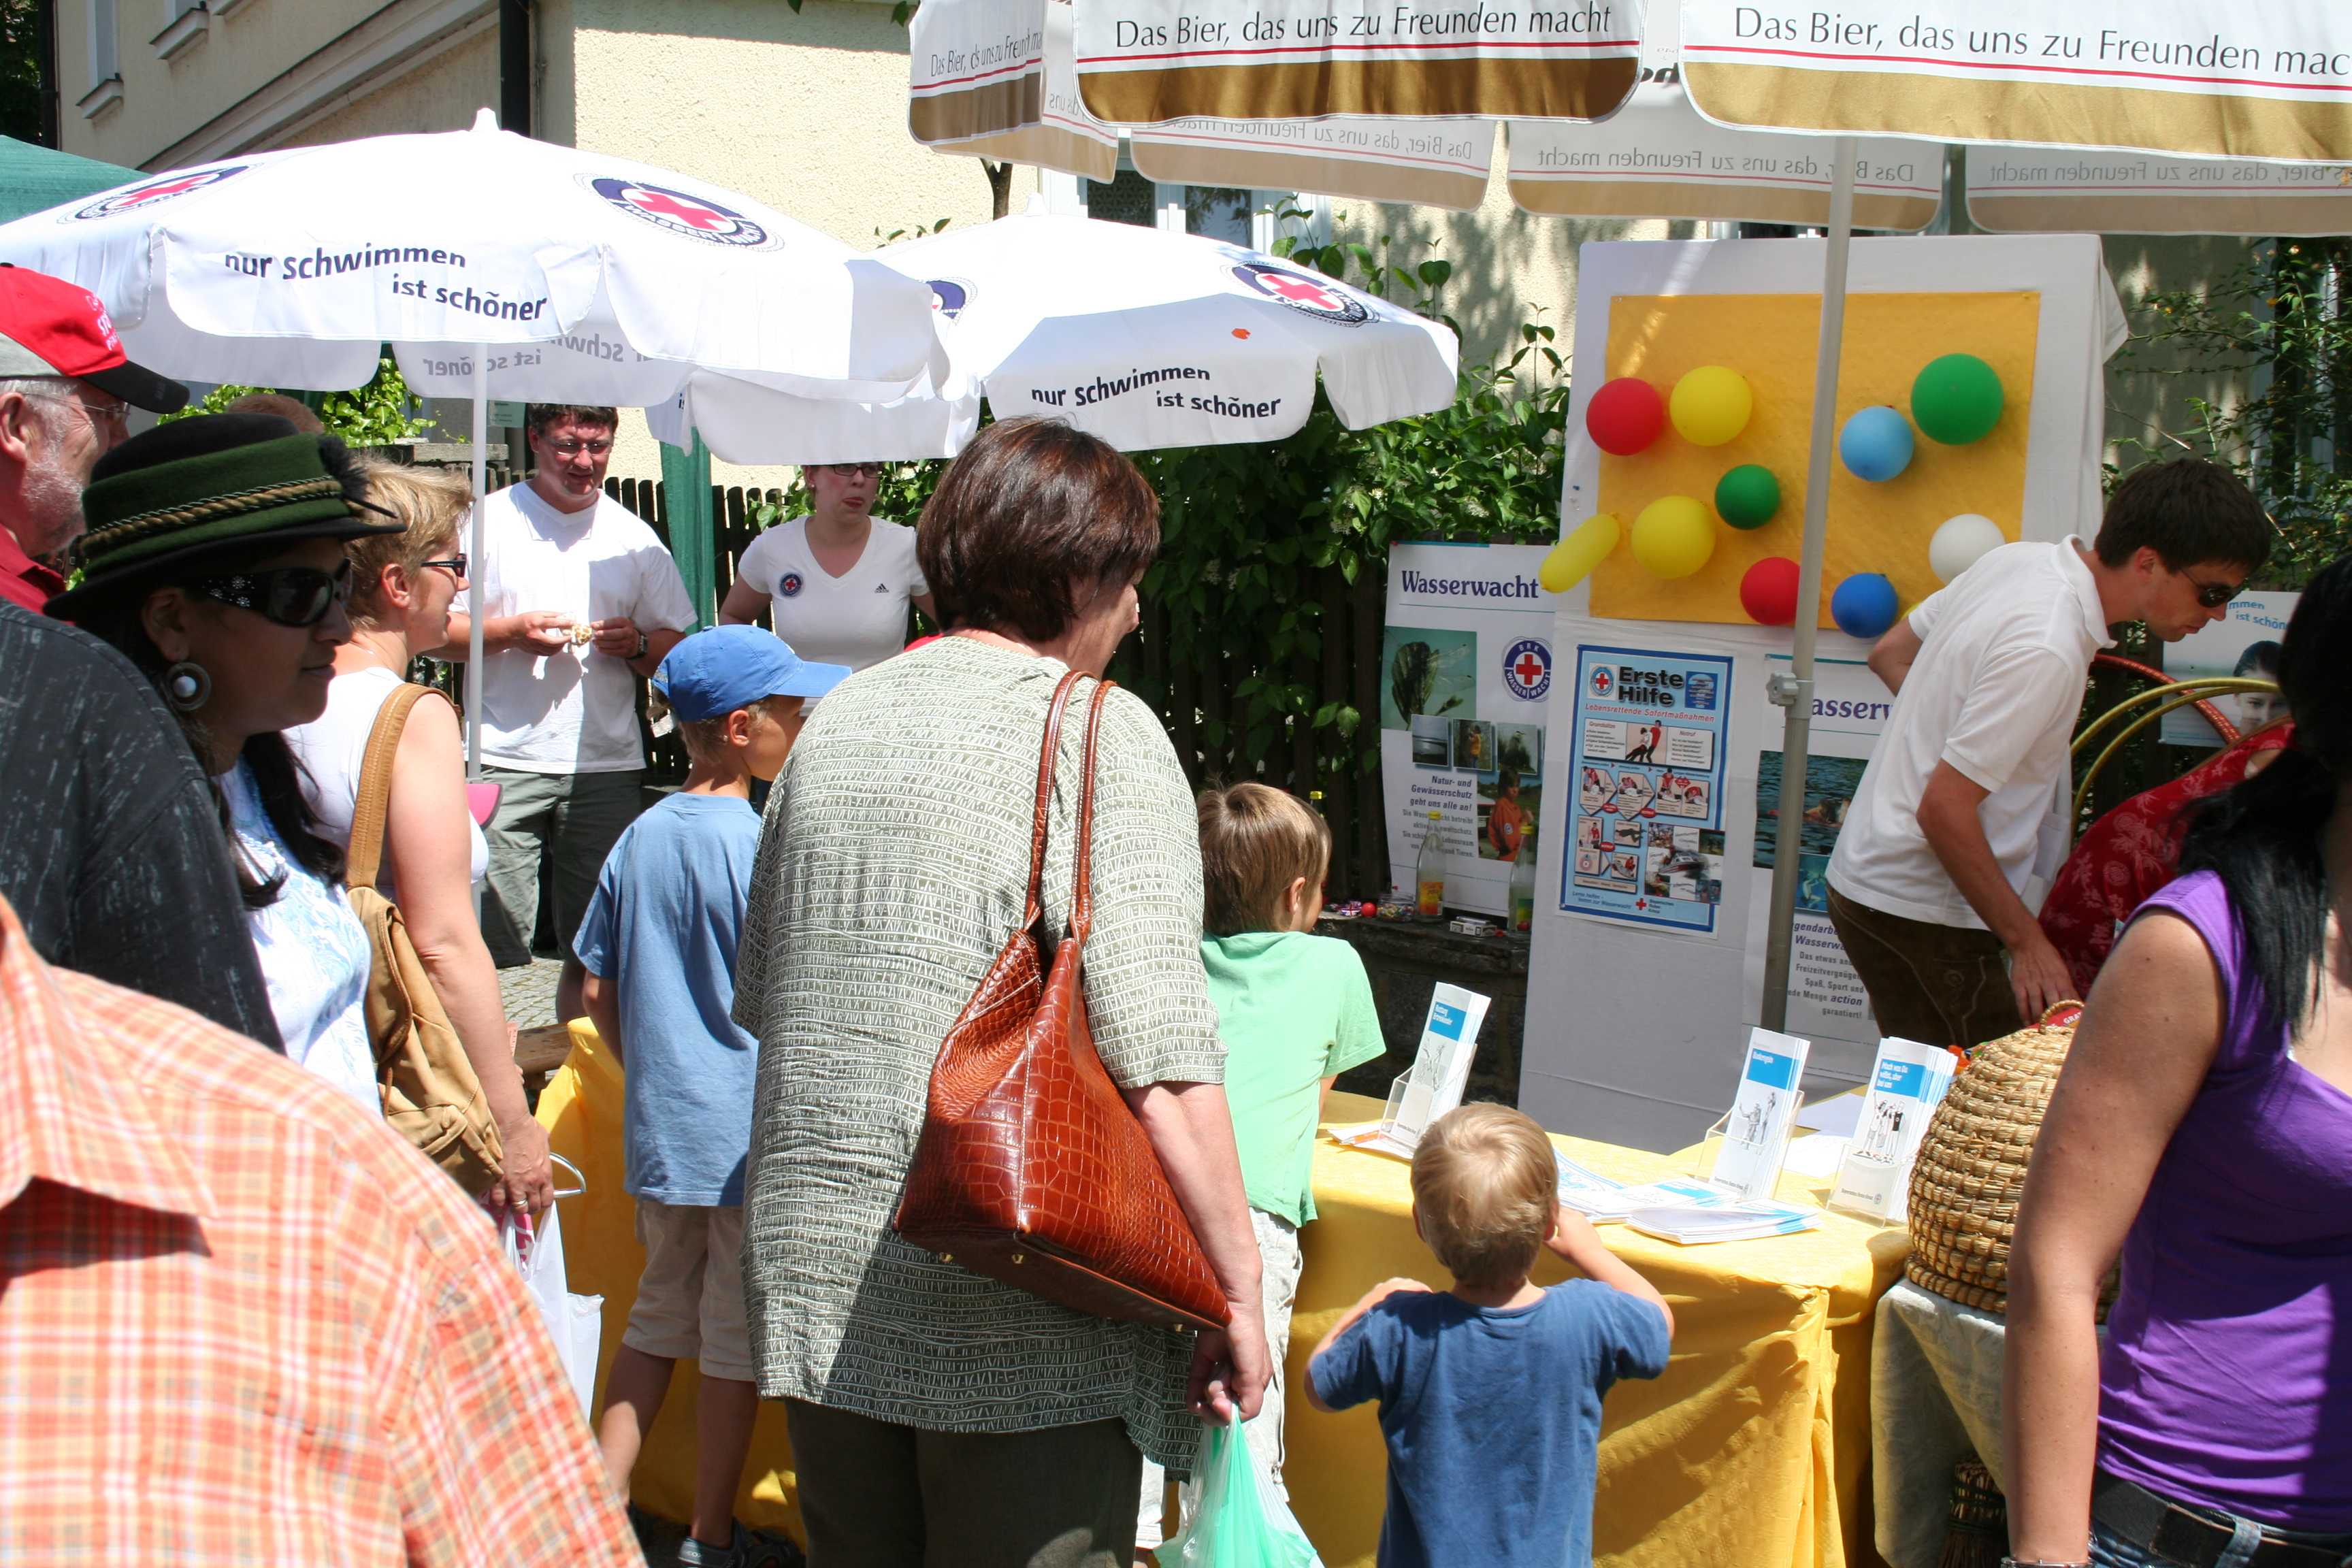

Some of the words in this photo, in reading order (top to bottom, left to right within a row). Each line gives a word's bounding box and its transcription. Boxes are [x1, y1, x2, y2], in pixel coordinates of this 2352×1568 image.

[1116, 20, 1167, 48] Das
[1177, 16, 1230, 47] Bier,
[1243, 11, 1285, 42] das
[1297, 15, 1338, 39] uns
[1349, 15, 1380, 36] zu
[1394, 1, 1516, 35] Freunden
[1528, 1, 1611, 33] macht
[1735, 7, 1797, 41] Das
[1810, 12, 1884, 52] Bier,
[1899, 15, 1955, 50] das
[1968, 30, 2028, 54] uns
[2041, 34, 2082, 58] zu
[2099, 29, 2260, 70] Freunden
[2274, 48, 2351, 76] mac
[225, 252, 272, 278] nur
[282, 242, 466, 280] schwimmen
[393, 273, 427, 299] ist
[1031, 389, 1066, 406] nur
[1075, 368, 1210, 406] schwimmen
[1156, 391, 1185, 408] ist
[1402, 570, 1538, 598] Wasserwacht
[1518, 642, 1539, 651] BRK
[1507, 671, 1526, 696] WASSER
[1530, 674, 1550, 696] WACHT
[1619, 666, 1684, 688] Erste
[1618, 685, 1674, 706] Hilfe
[1585, 703, 1642, 715] Lebensrettende
[1644, 708, 1715, 723] Sofortmaßnahmen
[1431, 775, 1455, 785] Natur-
[1457, 779, 1471, 787] und
[1411, 784, 1473, 799] Gewässerschutz
[1410, 797, 1426, 806] geht
[1443, 801, 1458, 809] alle
[1459, 804, 1472, 812] an!
[1799, 951, 1814, 960] Das
[1815, 955, 1837, 964] etwas
[1827, 981, 1848, 992] Sport
[1850, 985, 1865, 994] und
[1803, 990, 1828, 1002] Menge
[1830, 994, 1863, 1006] action
[1822, 1007, 1863, 1019] garantiert!
